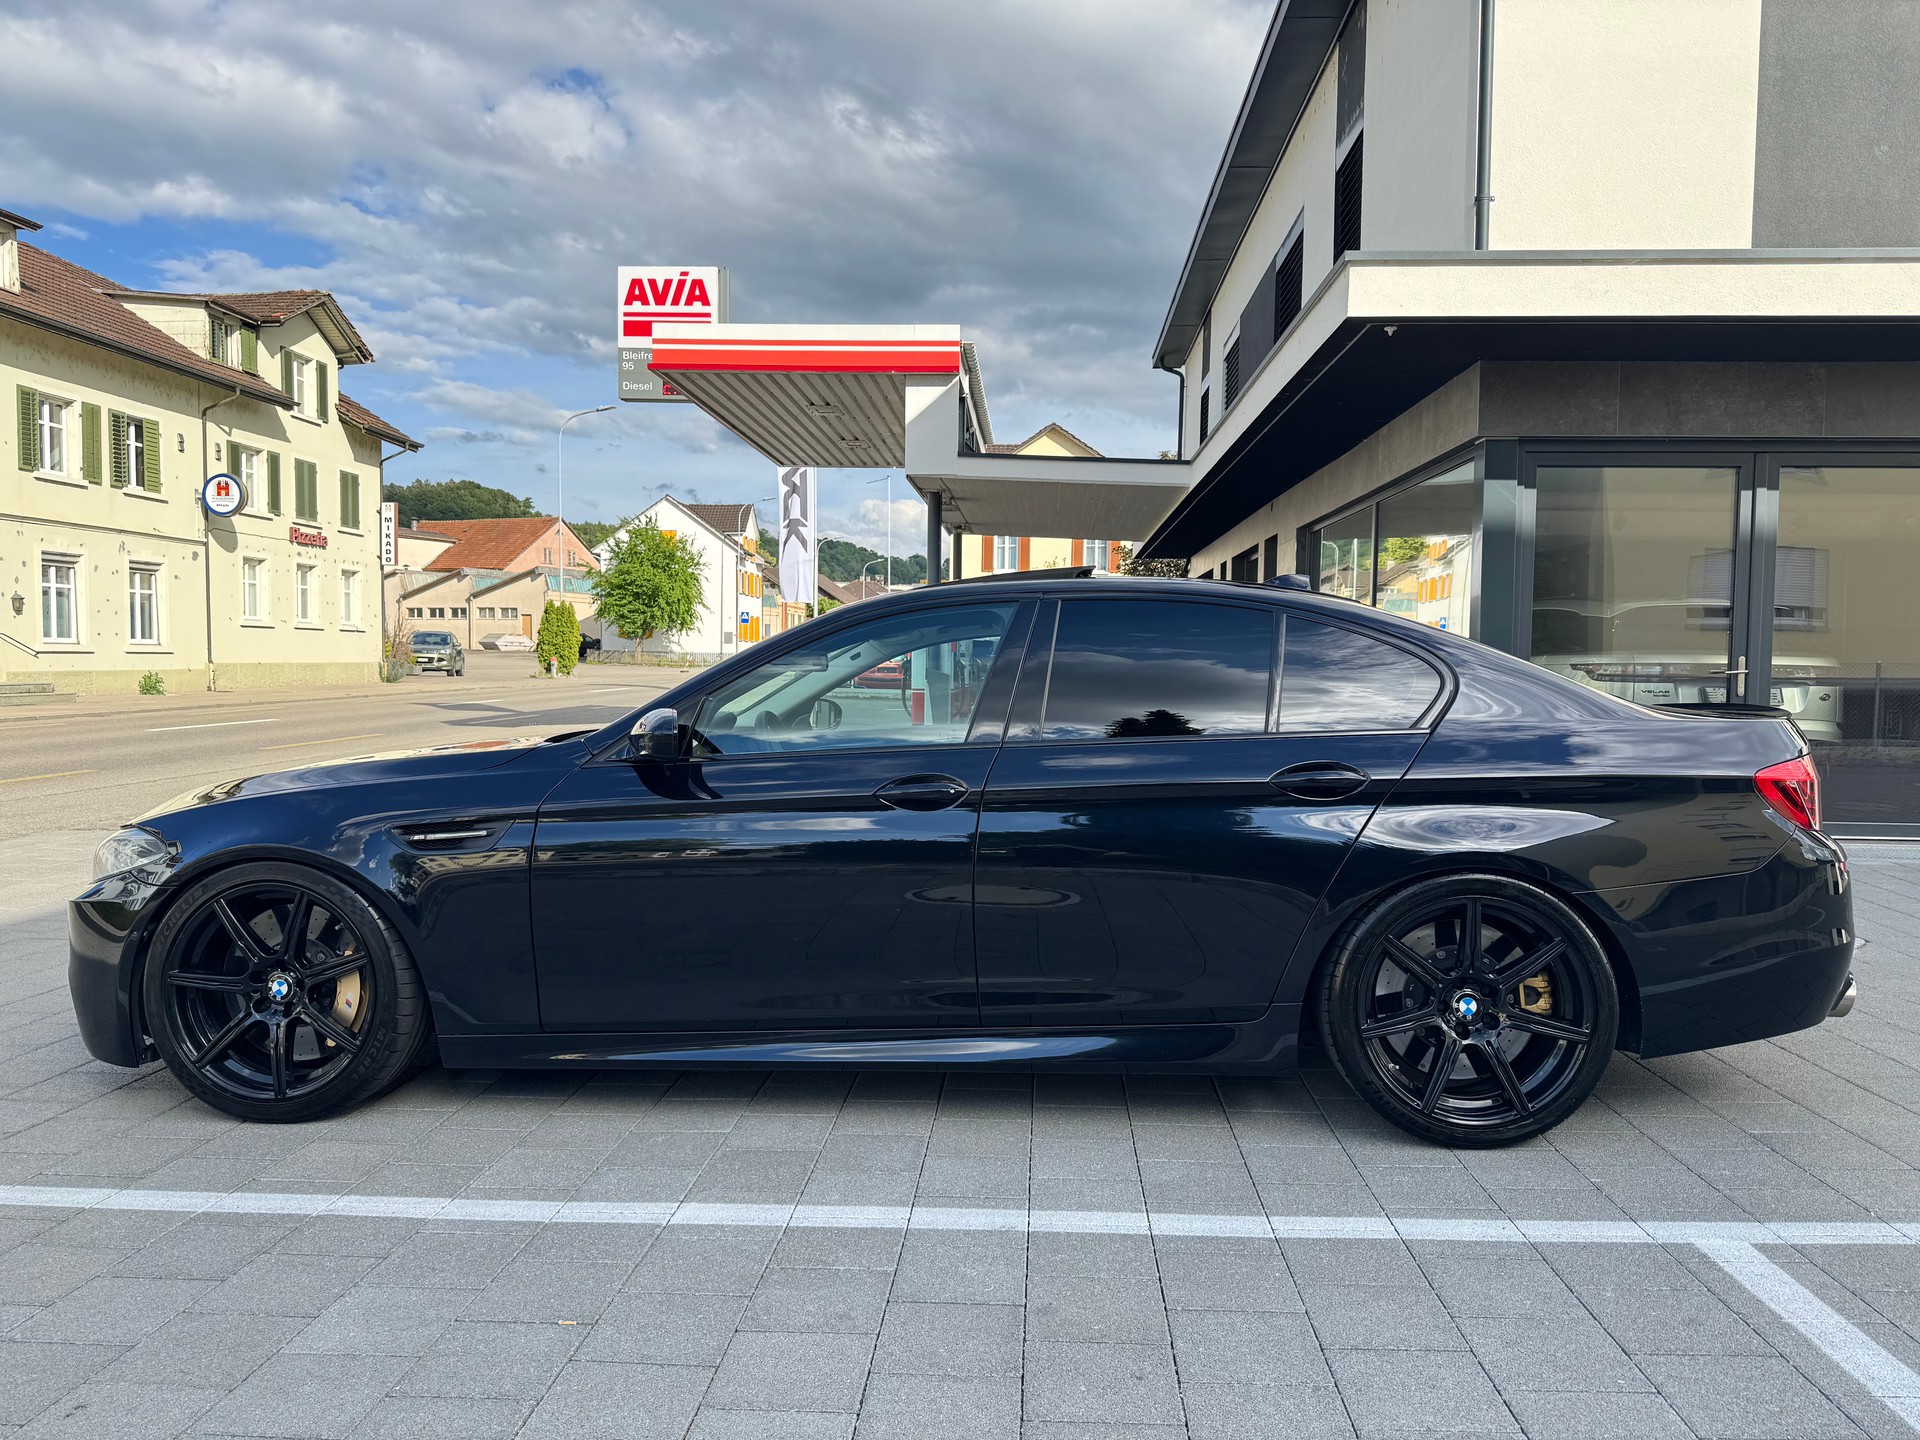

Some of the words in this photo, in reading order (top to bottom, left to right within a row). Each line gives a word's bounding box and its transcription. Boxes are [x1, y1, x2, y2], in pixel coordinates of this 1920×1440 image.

[622, 351, 653, 360] Bleifre
[622, 362, 635, 370] 95
[622, 381, 653, 391] Diesel
[290, 527, 328, 547] Pizzeria
[384, 517, 392, 563] MIKADO
